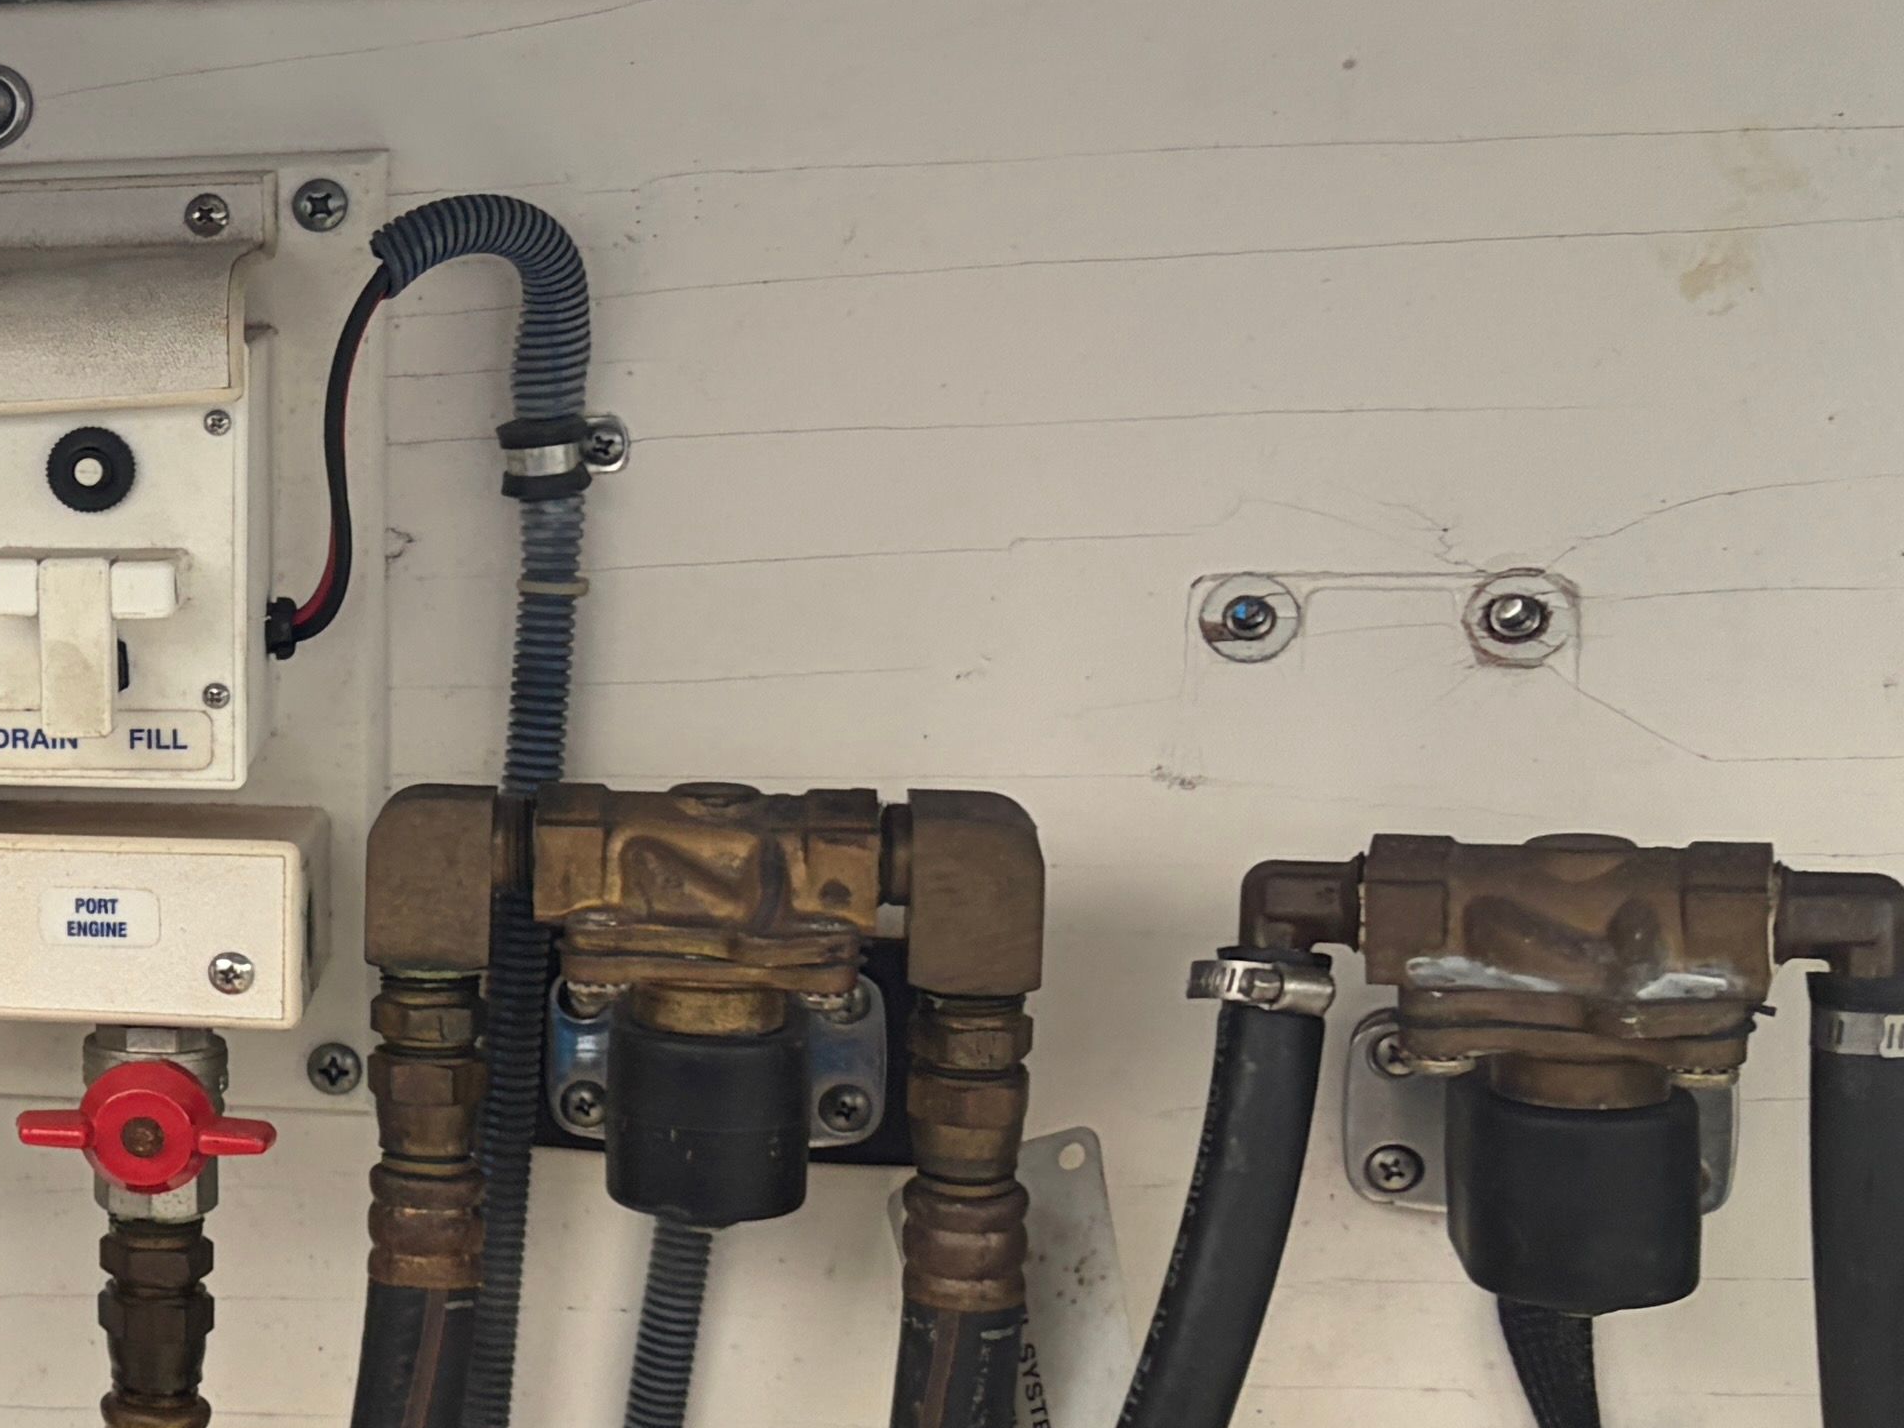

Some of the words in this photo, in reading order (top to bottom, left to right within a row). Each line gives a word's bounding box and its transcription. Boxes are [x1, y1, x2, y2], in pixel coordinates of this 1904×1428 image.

[129, 728, 188, 751] FILL
[73, 897, 119, 916] PORT
[65, 918, 128, 939] ENGINE
